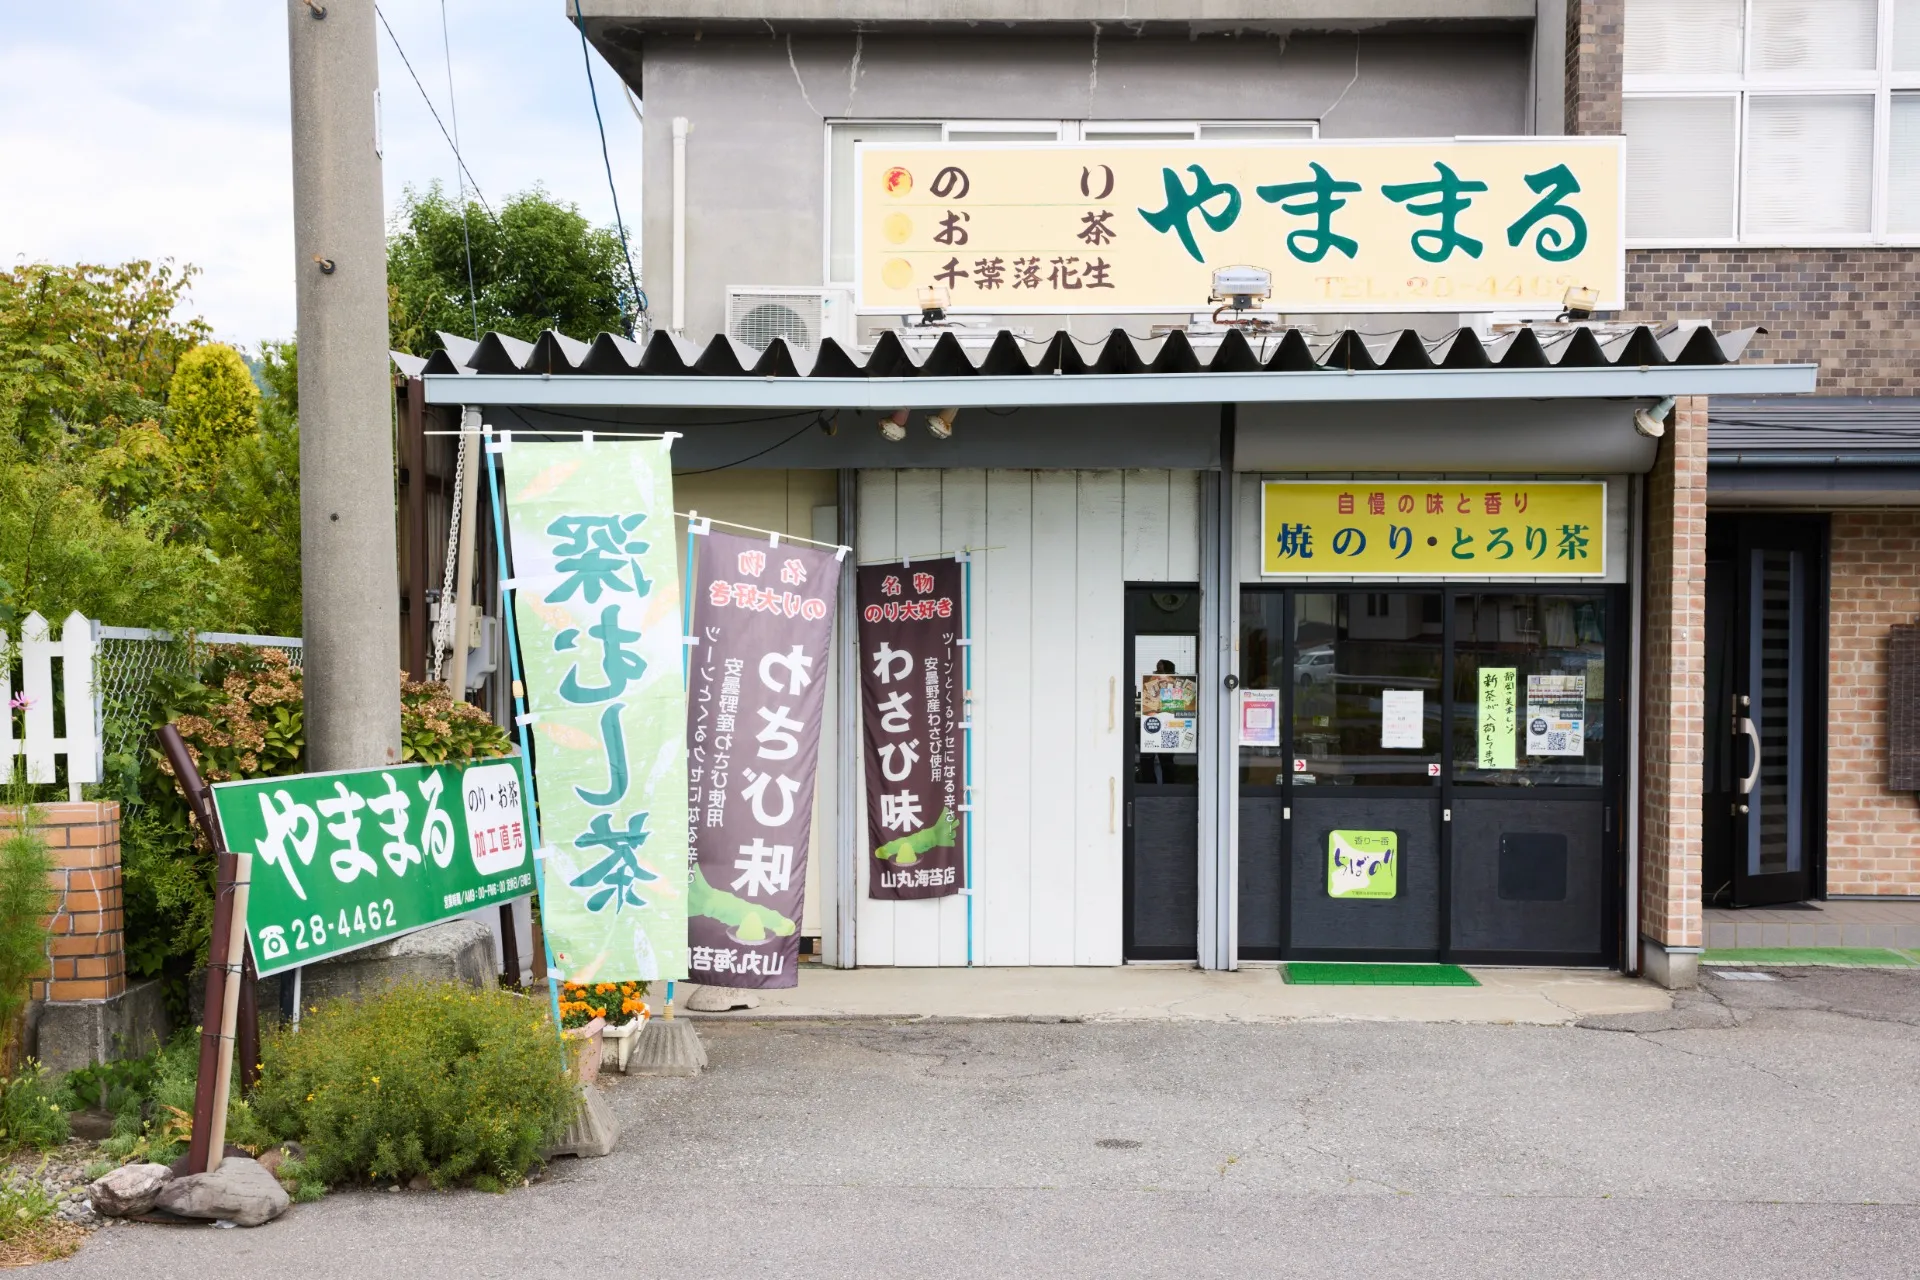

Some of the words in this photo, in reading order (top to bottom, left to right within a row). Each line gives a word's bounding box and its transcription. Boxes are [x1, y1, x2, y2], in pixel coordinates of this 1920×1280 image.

[1138, 162, 1588, 263] やままる
[929, 257, 1115, 290] 千葉落花生
[1338, 491, 1530, 516] 自慢の味と香り
[1277, 522, 1590, 561] 焼のり・とろり茶
[881, 573, 934, 596] 名物
[865, 597, 952, 622] のり大好き
[872, 641, 924, 832] わさび味
[923, 656, 942, 783] 安曇野産わさび使用
[468, 780, 519, 812] のり・お茶
[255, 769, 456, 901] やままる
[474, 821, 523, 858] 加工直売
[881, 867, 956, 889] 山丸海苔店
[292, 898, 397, 951] 28-4462
